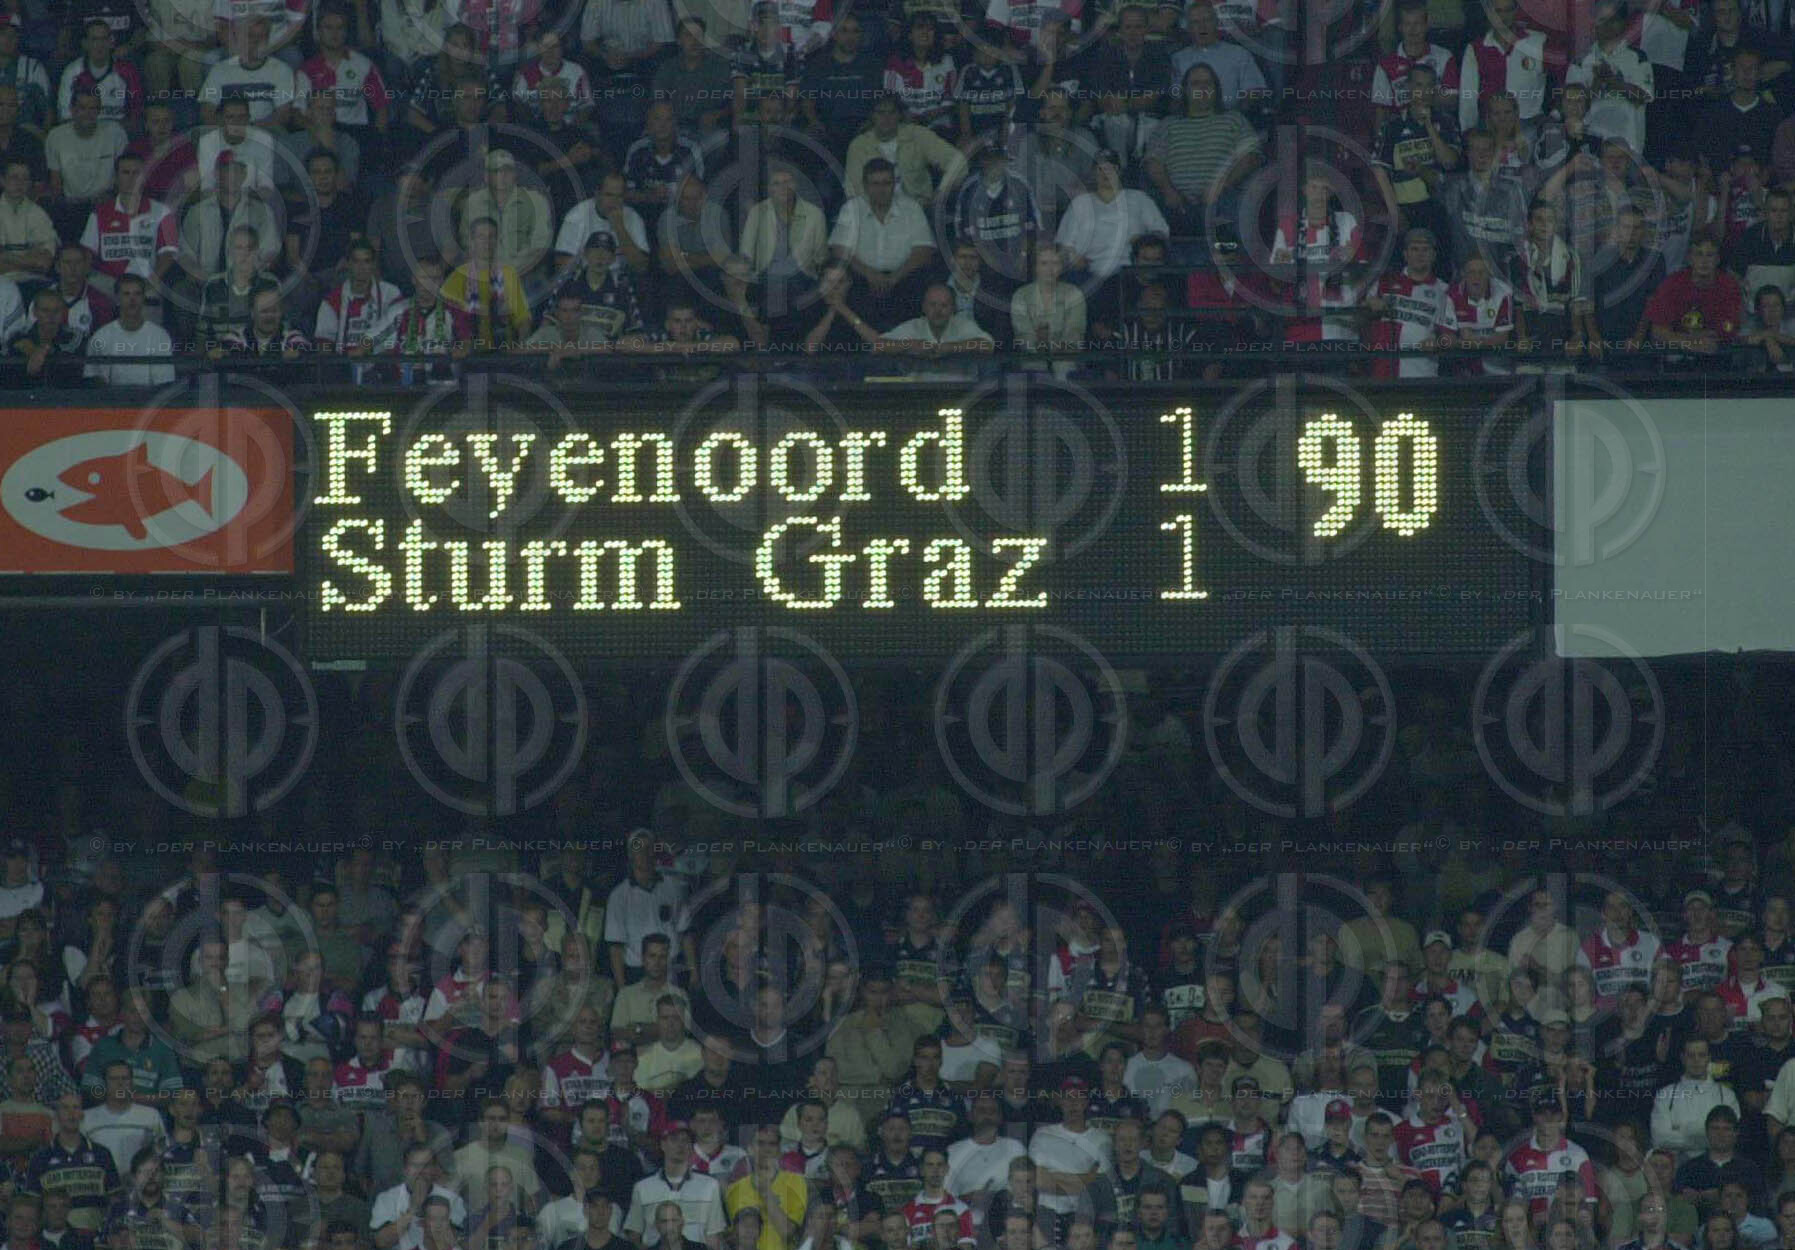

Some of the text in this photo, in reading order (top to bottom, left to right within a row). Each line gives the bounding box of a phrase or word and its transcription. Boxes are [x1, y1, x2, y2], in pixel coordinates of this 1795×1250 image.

[312, 406, 1439, 537] Feyenoord 1 90
[319, 513, 1208, 613] Sturm Graz 1
